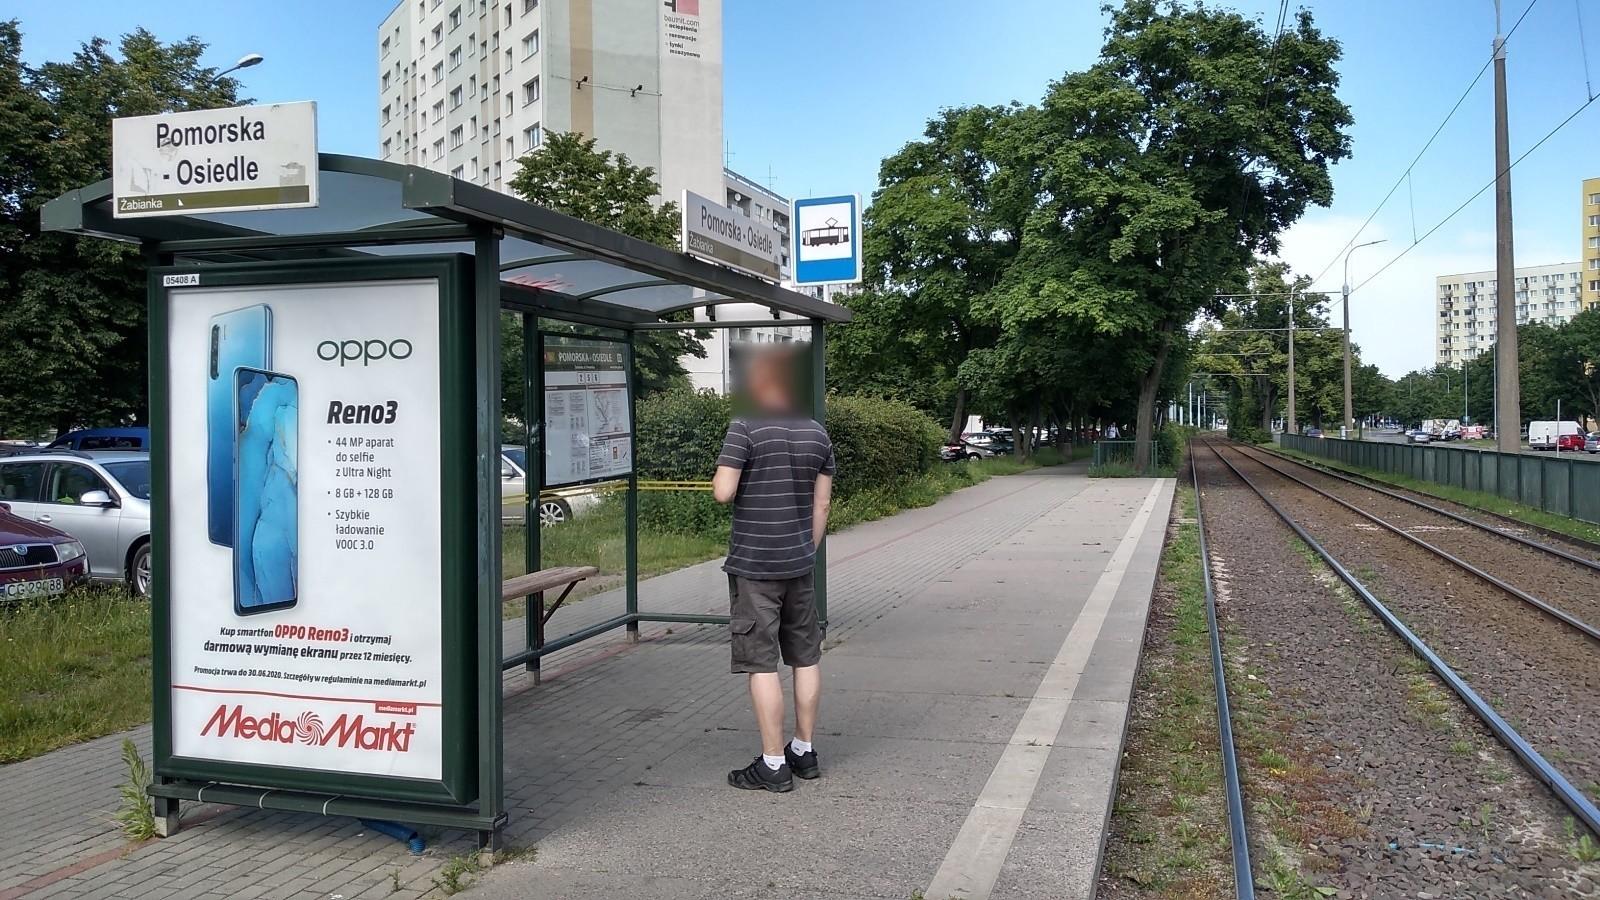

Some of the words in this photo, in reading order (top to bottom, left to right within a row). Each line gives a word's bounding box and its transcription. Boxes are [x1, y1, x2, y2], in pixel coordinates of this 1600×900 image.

[156, 116, 265, 149] Pomorska
[177, 155, 259, 185] Osiedle
[701, 205, 742, 242] Pomorska
[747, 226, 773, 255] Osiedle
[165, 275, 189, 285] 05408
[190, 275, 197, 284] A
[558, 351, 589, 363] POMORSKA
[592, 353, 613, 363] OSIEDLE
[327, 400, 399, 424] Reno3
[335, 437, 347, 447] 44
[349, 437, 364, 447] MP
[365, 437, 395, 449] aparat
[335, 452, 347, 462] do
[349, 452, 375, 462] selfie
[335, 468, 341, 477] z
[342, 467, 364, 477] Ultra
[366, 467, 392, 479] Night
[335, 488, 341, 498] 8
[343, 488, 355, 498] GB
[364, 488, 380, 499] 128
[382, 488, 394, 499] GB
[335, 509, 370, 521] Szybkie
[335, 524, 385, 535] ładowanie
[335, 539, 358, 550] VOOC
[359, 540, 374, 550] 3.0
[8, 584, 25, 597] CG
[220, 627, 236, 637] Kup
[237, 628, 274, 638] smartfon
[274, 624, 306, 640] OPPO
[307, 626, 350, 642] Reno3
[353, 634, 392, 645] otrzymaj
[203, 640, 252, 655] darmową
[253, 643, 299, 659] wymianę
[300, 646, 339, 659] ekranu
[339, 652, 362, 661] przez
[363, 652, 372, 661] 12
[373, 652, 412, 664] miesięcy.
[194, 665, 220, 675] Promocja
[221, 668, 237, 676] trwa
[238, 668, 247, 676] do
[283, 671, 314, 682] Szczegóły
[321, 675, 363, 685] regulaminie
[373, 678, 427, 689] mediamarkt.pl
[200, 704, 297, 744] Media
[319, 713, 415, 752] Markt
